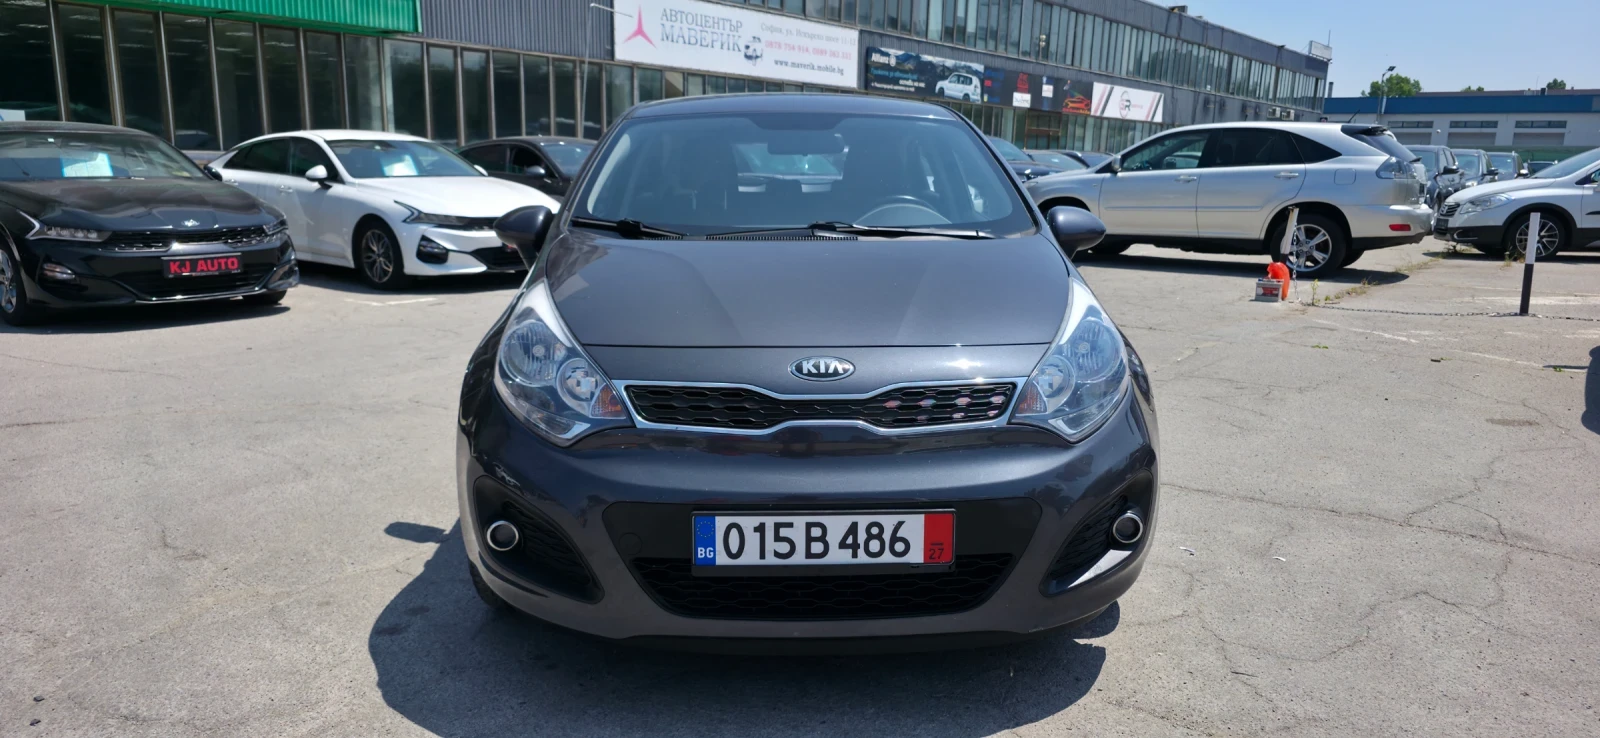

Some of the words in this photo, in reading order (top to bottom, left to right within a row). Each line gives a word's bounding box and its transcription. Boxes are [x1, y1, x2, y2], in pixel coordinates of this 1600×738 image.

[660, 8, 743, 33] АВТОЦЕНТЪР
[660, 23, 742, 52] МАВЕРИК
[774, 59, 845, 76] www.maverik.mobile.bg
[169, 260, 191, 274] KJ
[196, 257, 239, 272] AUTO
[801, 360, 844, 374] KIA
[697, 547, 714, 559] BG
[928, 548, 945, 560] 27
